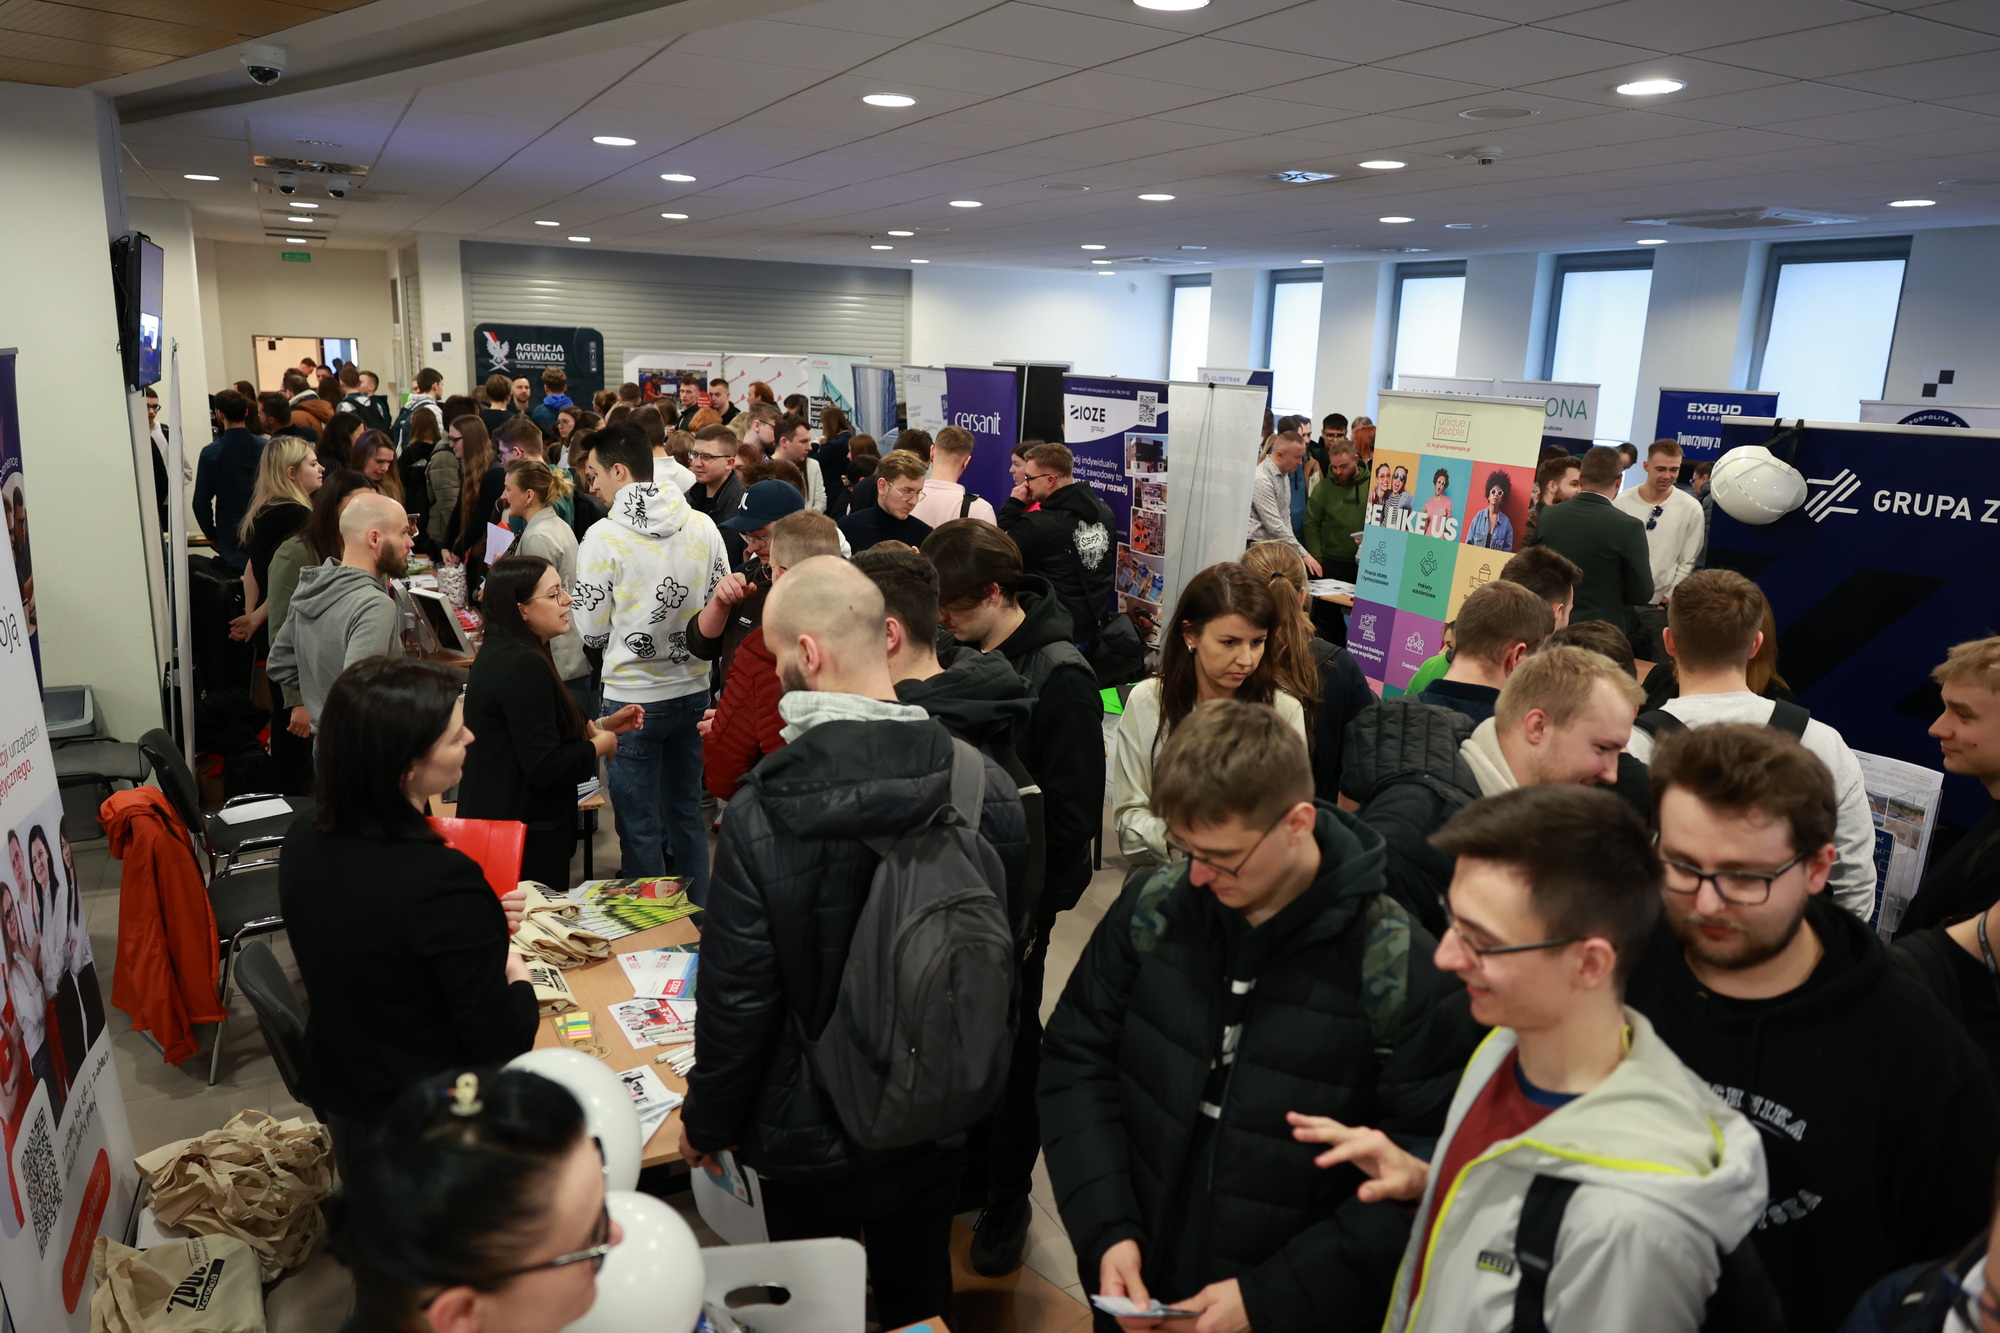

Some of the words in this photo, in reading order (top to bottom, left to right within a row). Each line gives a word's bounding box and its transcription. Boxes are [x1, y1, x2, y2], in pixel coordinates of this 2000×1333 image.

[515, 343, 564, 352] AGENCJA
[516, 351, 565, 361] WYWIADU
[1687, 402, 1742, 415] EXBUD
[954, 412, 1001, 436] cersanit
[1091, 425, 1105, 433] group
[1439, 417, 1466, 429] unique
[1437, 427, 1465, 438] people
[1677, 432, 1714, 450] Tworzymy
[1082, 456, 1118, 471] indywidualny
[1087, 469, 1115, 481] zawodowy
[1116, 473, 1123, 481] to
[1107, 484, 1128, 496] rozwój
[1873, 490, 1972, 521] GRUPA
[1980, 499, 2000, 523] Z
[1365, 503, 1383, 526] BE
[1386, 506, 1429, 535] LIKE
[1431, 515, 1459, 541] US
[1364, 569, 1376, 577] Praca
[1418, 582, 1433, 592] Pakiety
[1347, 640, 1363, 650] sparcie
[8, 721, 40, 758] urządzeń
